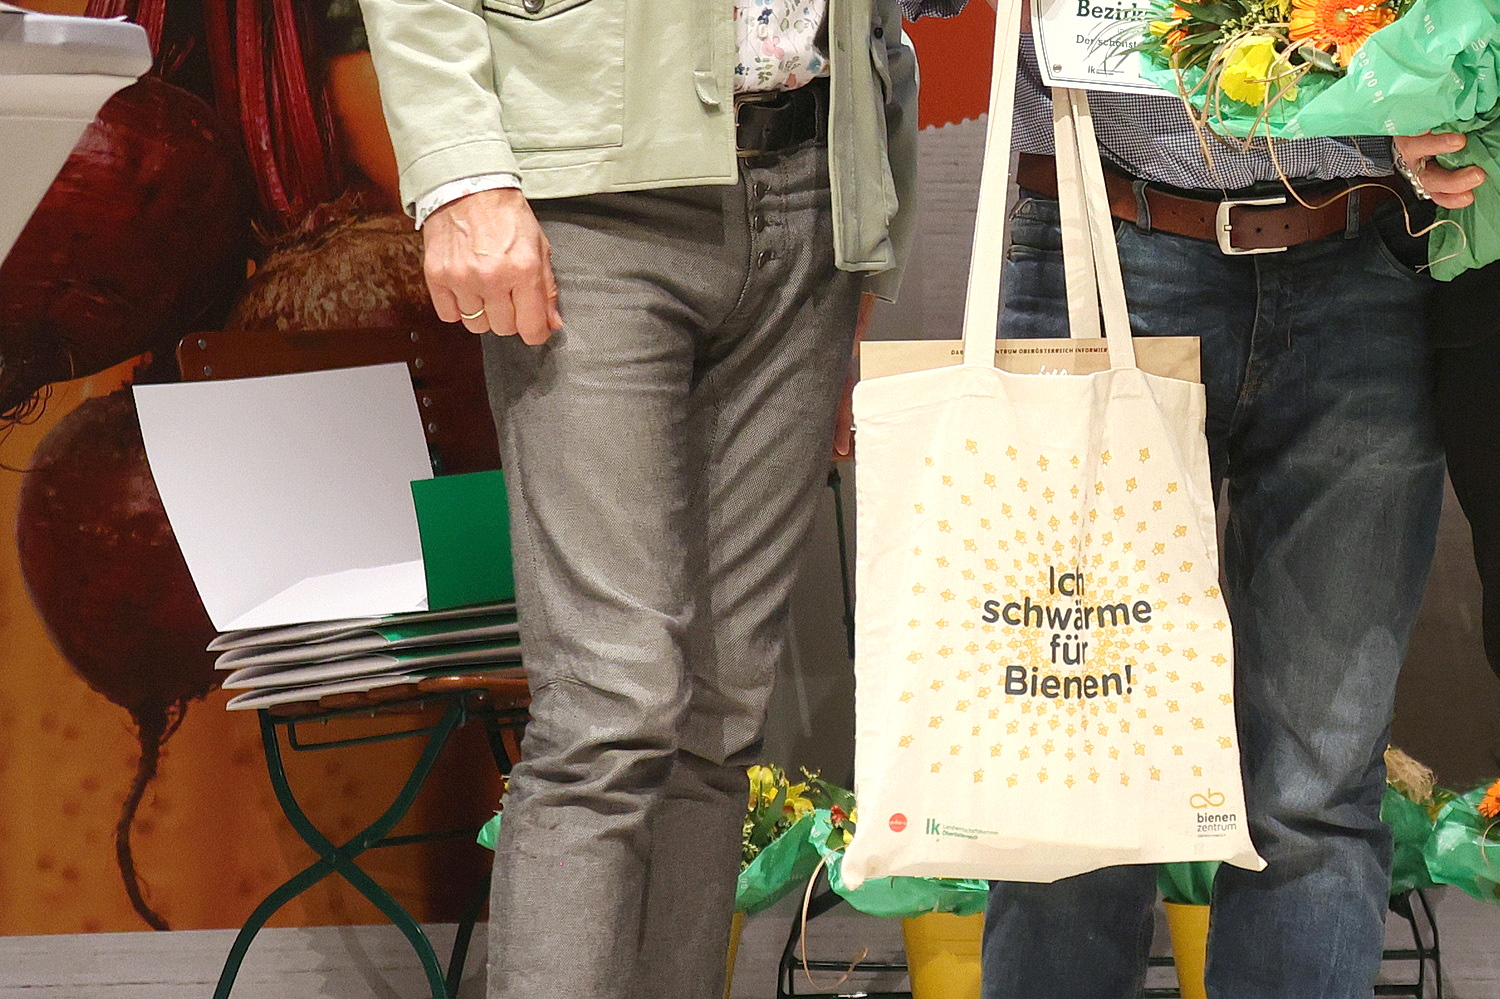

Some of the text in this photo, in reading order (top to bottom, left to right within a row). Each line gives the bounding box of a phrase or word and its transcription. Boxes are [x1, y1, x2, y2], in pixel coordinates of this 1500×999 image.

[1049, 564, 1085, 597] Ich
[981, 596, 1152, 631] schwärme
[1049, 633, 1088, 665] für
[1004, 664, 1132, 700] Bienen!
[1196, 812, 1237, 823] bienen
[1196, 823, 1237, 833] zentrum
